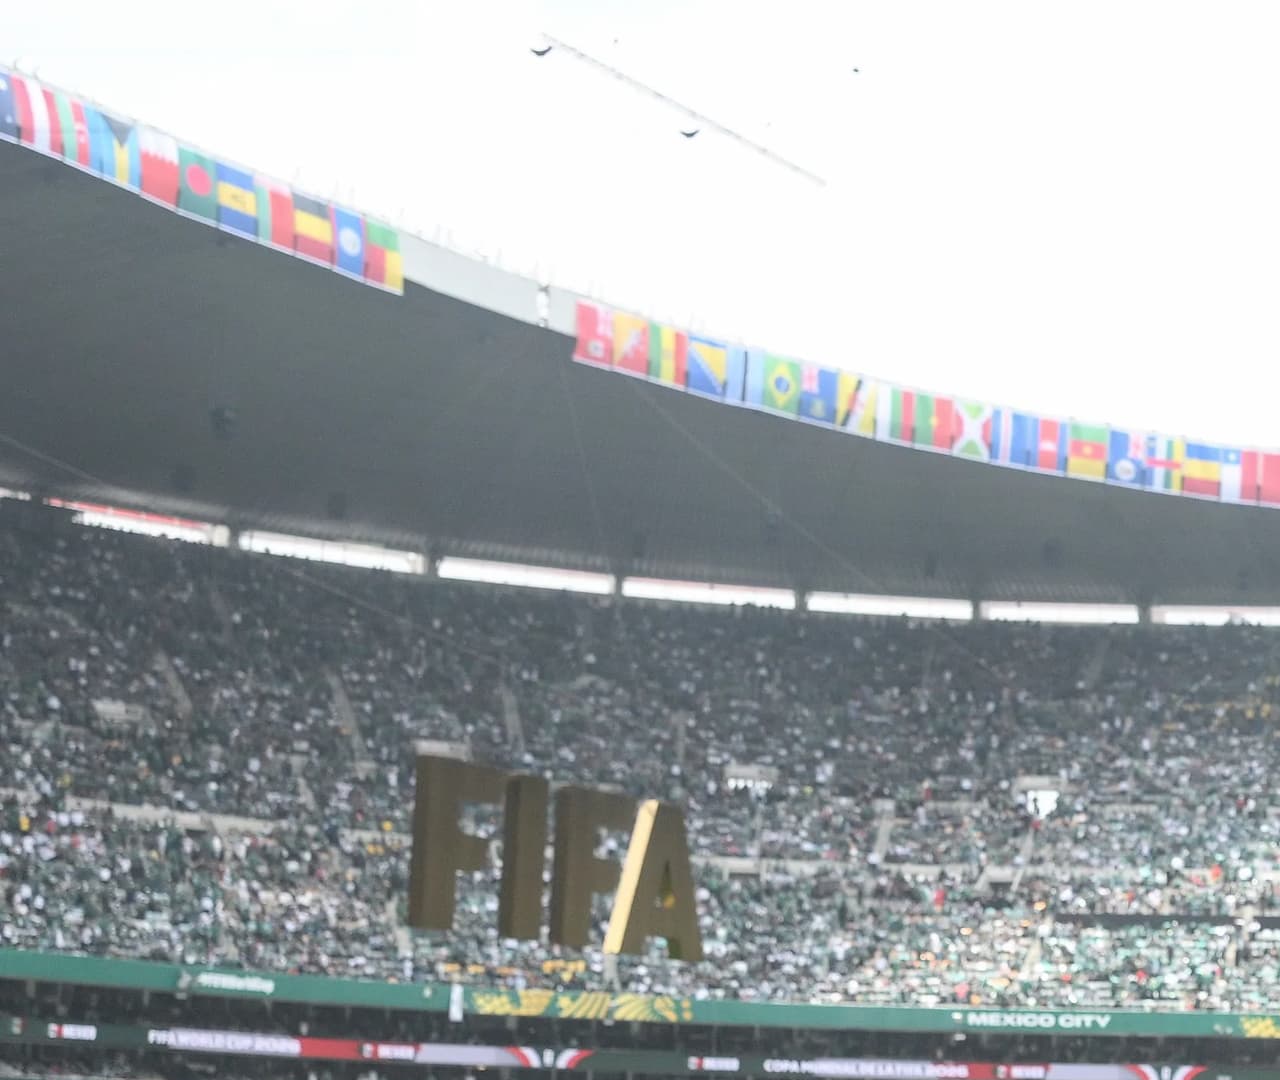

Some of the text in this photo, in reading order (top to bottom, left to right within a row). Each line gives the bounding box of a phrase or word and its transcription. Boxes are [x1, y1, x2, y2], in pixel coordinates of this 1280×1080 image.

[407, 747, 703, 961] FIFA
[966, 1012, 1112, 1028] MEXICO CITY
